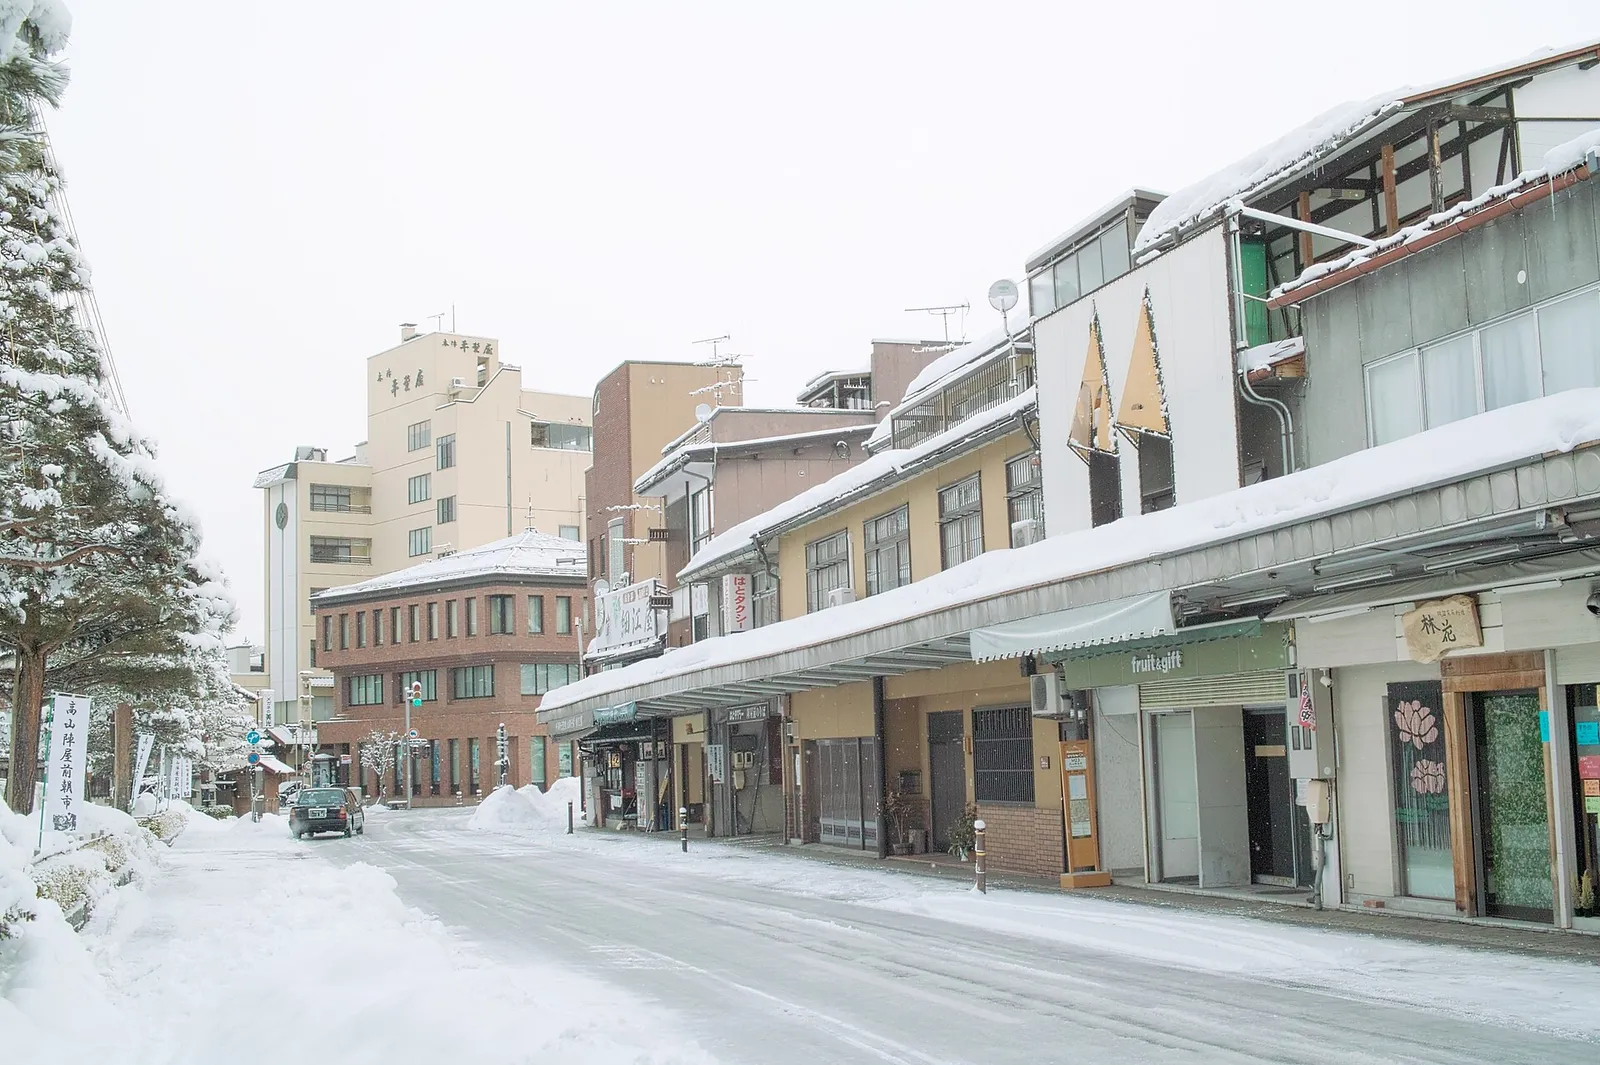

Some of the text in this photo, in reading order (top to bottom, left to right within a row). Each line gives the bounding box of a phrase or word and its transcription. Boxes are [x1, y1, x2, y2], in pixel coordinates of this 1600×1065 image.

[734, 576, 747, 629] はとタクシー
[1420, 614, 1457, 643] 林花
[1131, 650, 1182, 674] fruit&gift
[59, 700, 78, 810] 高山陣屋前朝市
